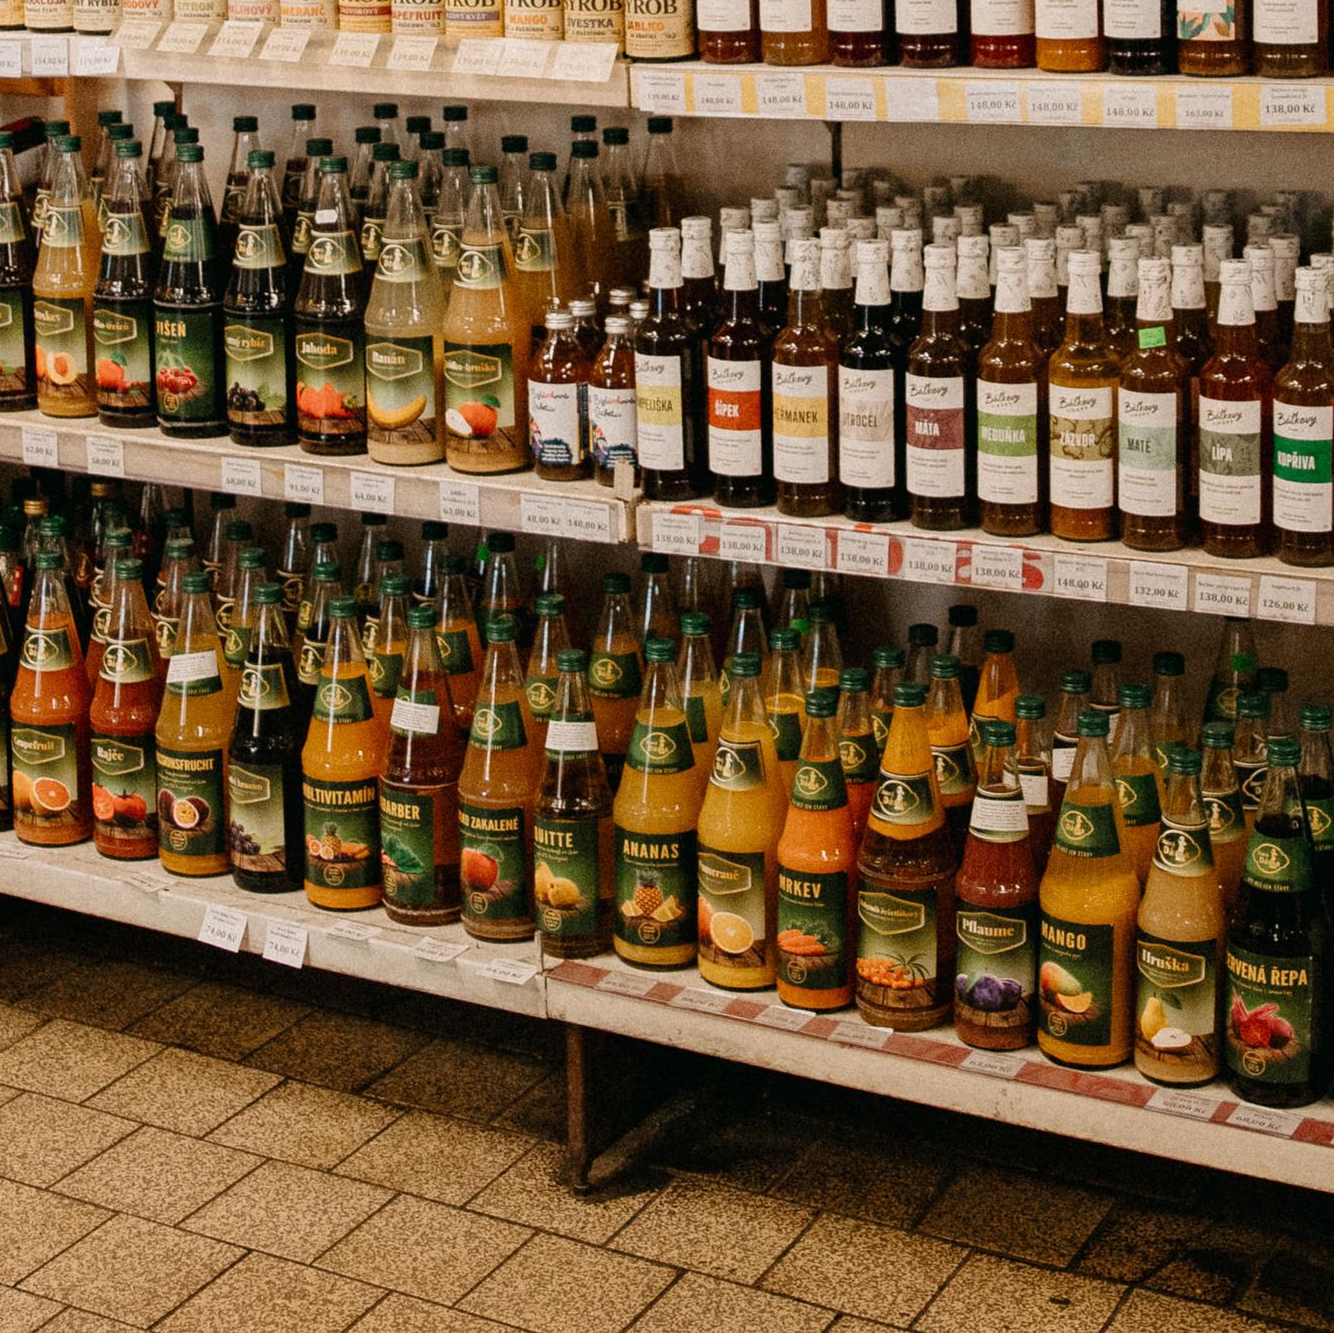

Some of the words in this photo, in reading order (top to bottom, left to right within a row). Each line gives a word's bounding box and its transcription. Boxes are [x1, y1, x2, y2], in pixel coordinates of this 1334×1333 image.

[1265, 103, 1300, 114] 138,00
[1302, 103, 1316, 114] Kč
[302, 342, 338, 356] Jahoda
[372, 351, 405, 367] Banán
[715, 402, 740, 418] ŠÍPEK
[1277, 411, 1317, 426] Báťkovy
[915, 421, 940, 438] MÁTA
[1127, 438, 1152, 454] MATÉ
[1211, 445, 1233, 463] LÍPA
[1277, 451, 1315, 471] KOPŘIVA
[975, 567, 1005, 579] 138,00
[1007, 569, 1021, 580] Kč
[1057, 577, 1089, 590] 148,00
[1090, 580, 1105, 591] Kč
[1134, 586, 1166, 598] 132,00
[1167, 588, 1181, 599] Kč
[1199, 593, 1233, 605] 138,00
[1234, 595, 1249, 607] Kč
[1262, 598, 1295, 611] 126,00
[1296, 601, 1310, 612] Kč
[97, 747, 124, 762] Rajče
[471, 810, 519, 831] ZAKALENÉ
[623, 838, 679, 859] ANANAS
[779, 874, 822, 899] MRKEV
[962, 918, 1015, 938] Pflaume
[1041, 920, 1087, 951] MANGO
[1141, 948, 1190, 972] Hruška
[1271, 964, 1307, 986] ŘEPA
